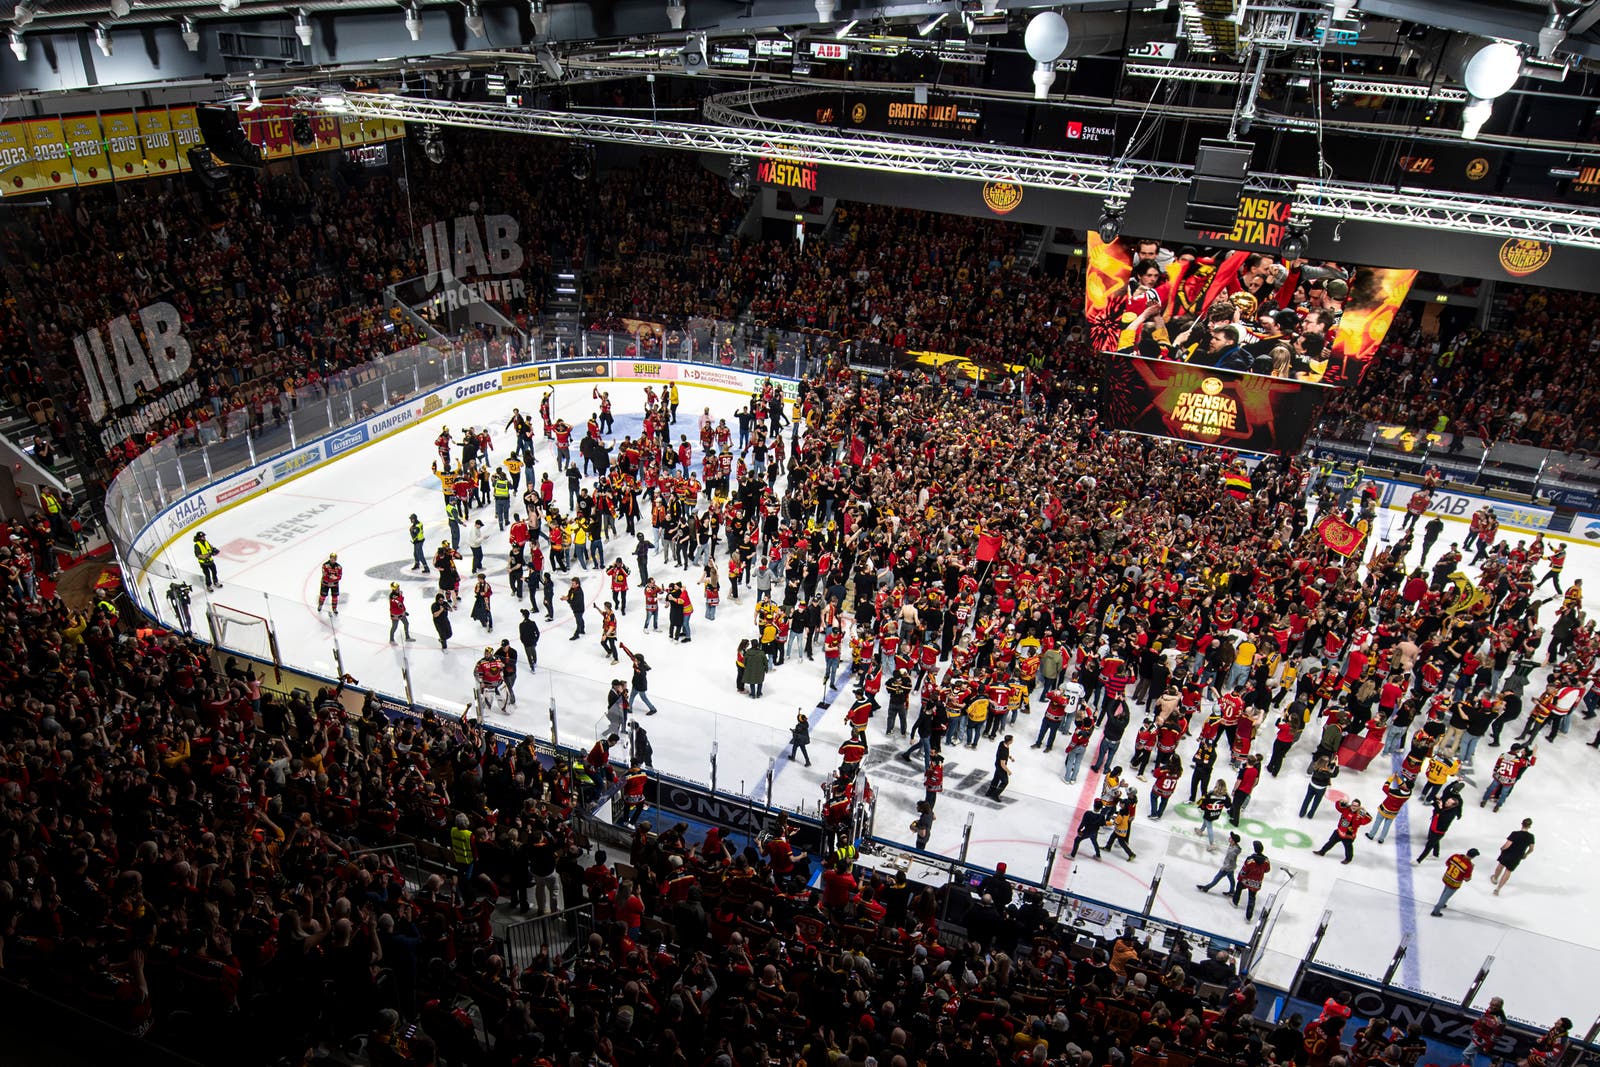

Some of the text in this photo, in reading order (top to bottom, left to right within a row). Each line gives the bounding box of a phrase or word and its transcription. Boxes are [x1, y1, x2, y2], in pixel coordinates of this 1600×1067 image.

[817, 45, 842, 57] ABB
[888, 103, 926, 119] GRATTIS
[929, 104, 958, 122] LULEÅ
[267, 114, 284, 138] 12
[1083, 126, 1116, 135] SVENSKA
[111, 136, 137, 153] 2019
[146, 133, 170, 149] 2018
[178, 129, 201, 145] 2016
[1082, 133, 1099, 141] SPEL
[73, 140, 101, 157] 2021
[756, 161, 818, 191] MÄSTARE
[422, 214, 524, 293] JIAB
[73, 301, 192, 413] JIAB
[507, 373, 536, 381] ZEPPELIN
[540, 369, 551, 378] CAT
[633, 363, 661, 374] SPORT
[456, 379, 498, 399] Granec
[1176, 392, 1238, 414] SVENSKA
[1170, 405, 1237, 430] MÄSTARE
[1181, 423, 1222, 436] SHL 2025
[722, 458, 731, 466] 26
[175, 494, 206, 521] HALA
[256, 503, 335, 539] SVENSKA
[271, 523, 319, 543] SPEL
[1500, 762, 1514, 776] 24
[1162, 778, 1177, 789] 97
